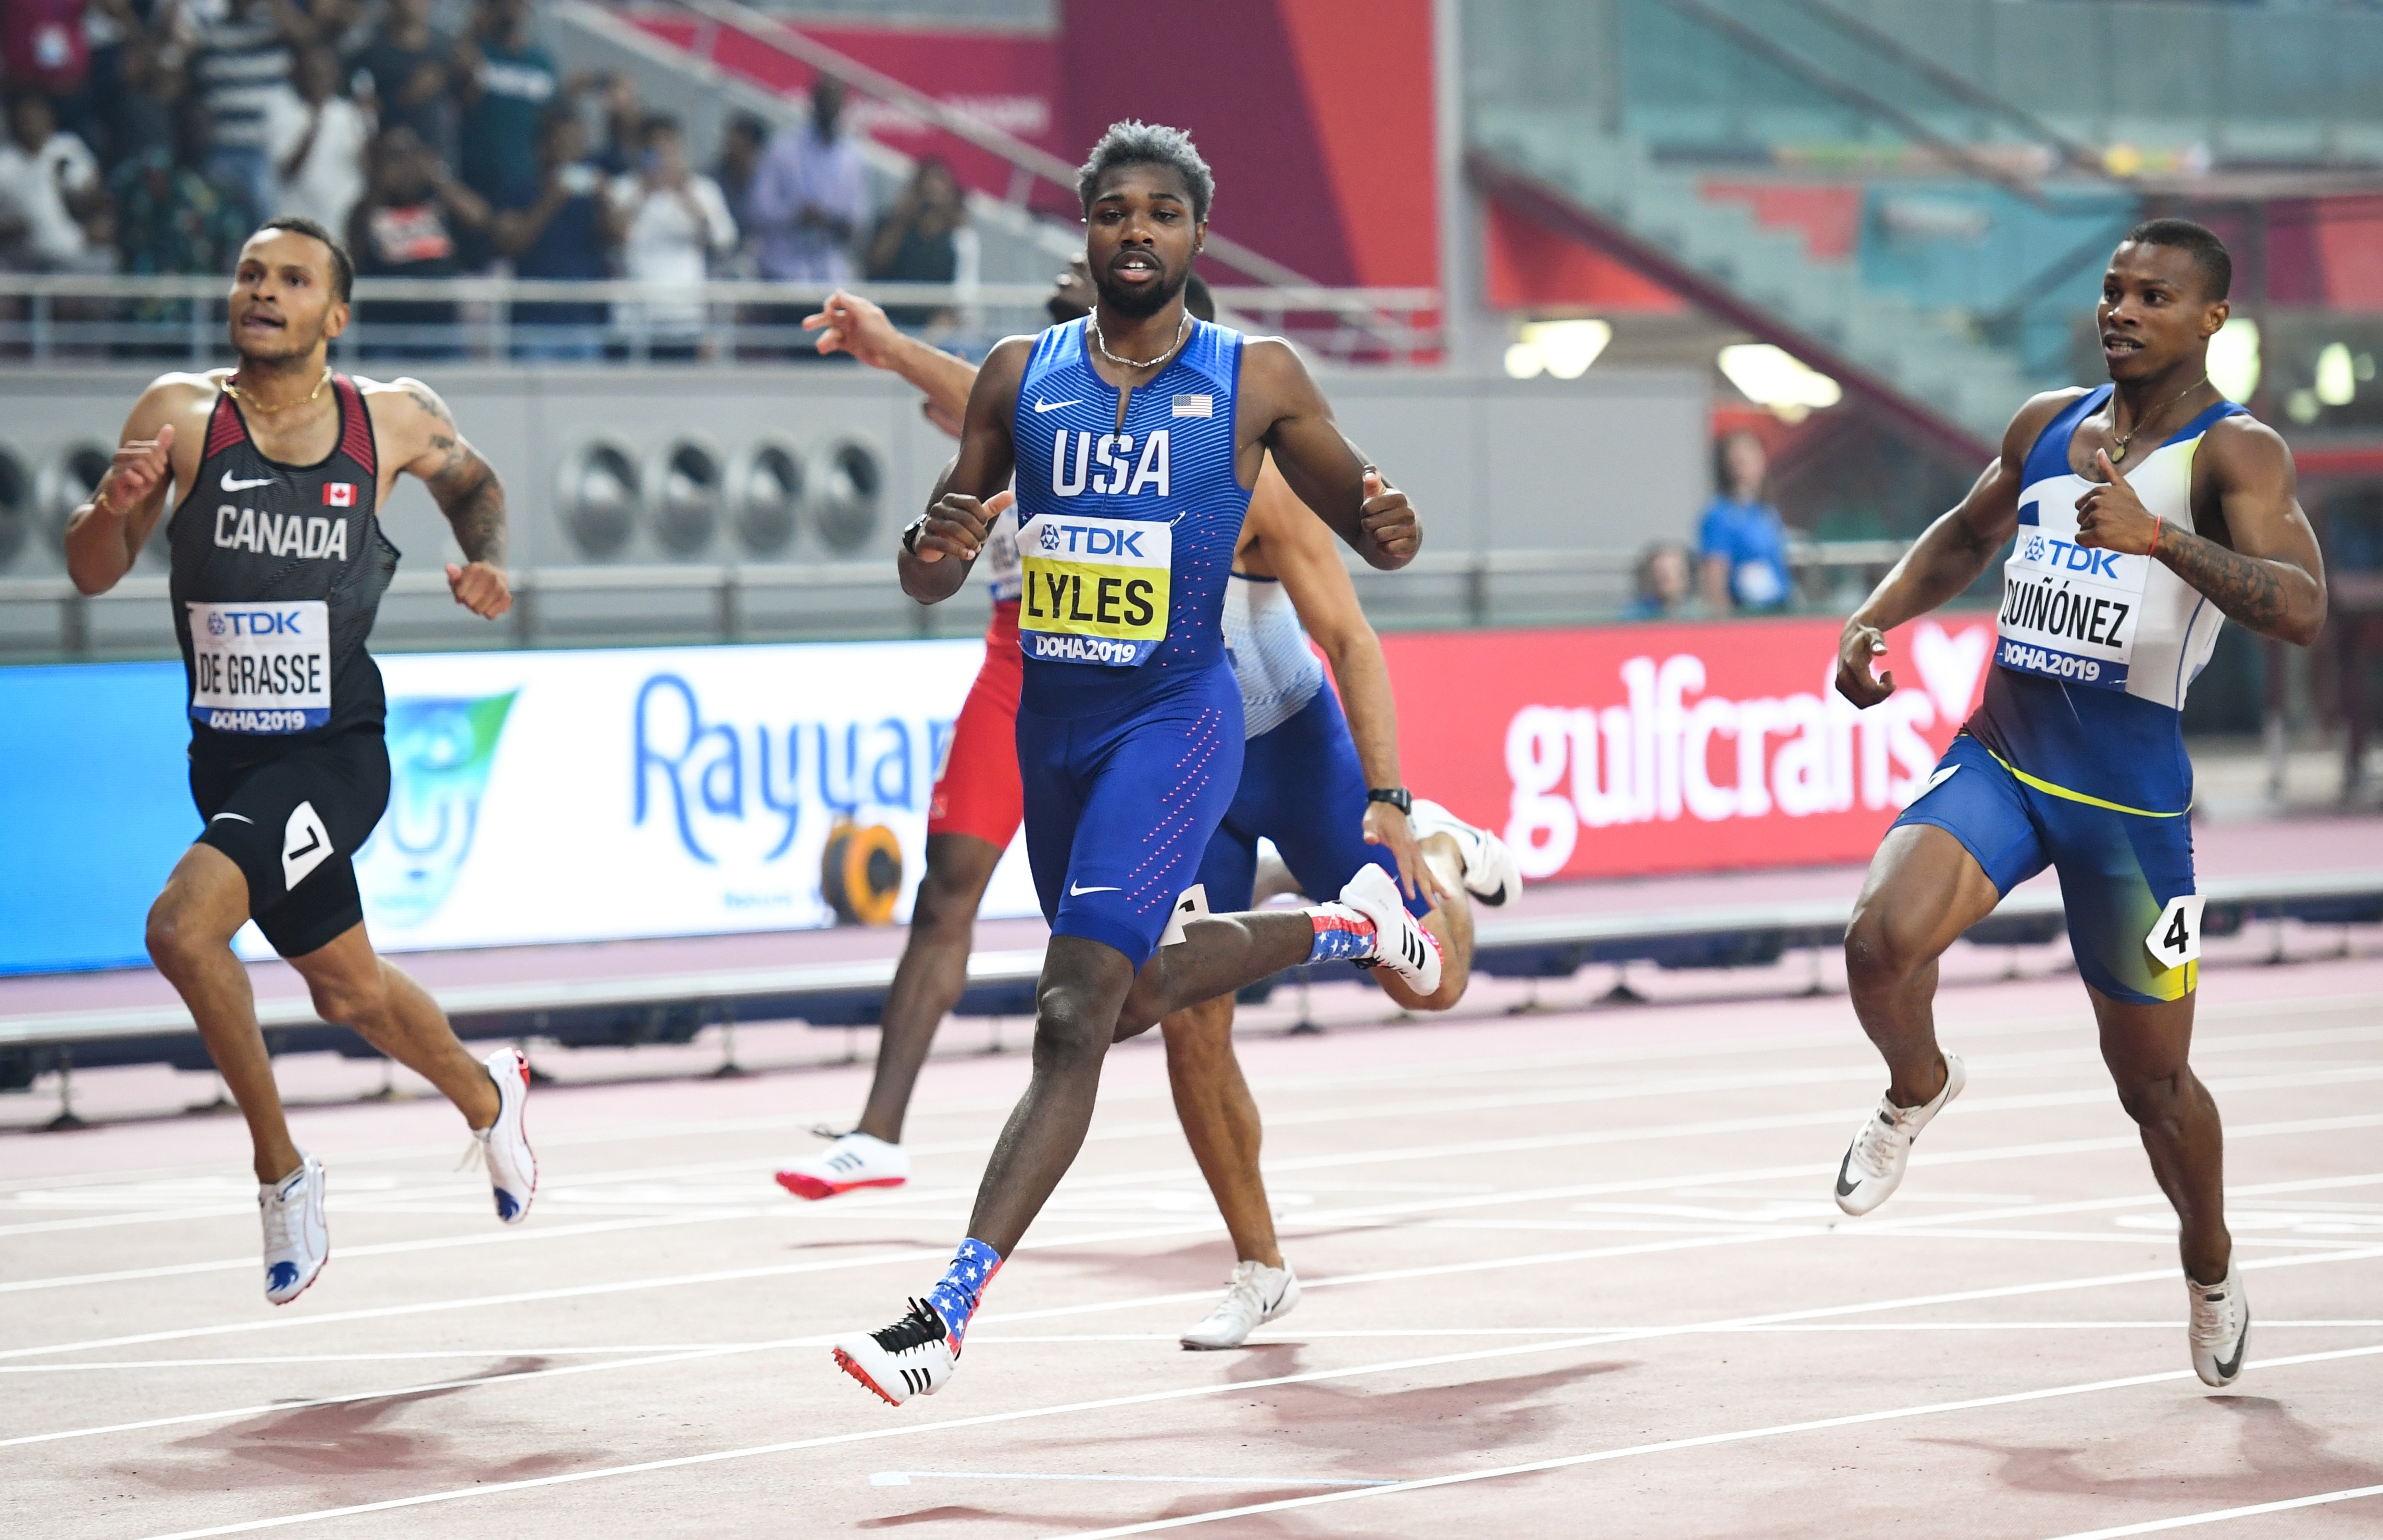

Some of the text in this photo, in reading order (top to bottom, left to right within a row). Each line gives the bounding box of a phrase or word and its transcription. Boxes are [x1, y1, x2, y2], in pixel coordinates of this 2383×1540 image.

[1052, 429, 1171, 497] USA
[214, 504, 348, 561] CANADA
[1061, 525, 1145, 558] TDK
[2049, 539, 2122, 580] TDK
[1028, 570, 1154, 626] LYLES
[2001, 576, 2130, 648] QUIÑÓNEZ
[224, 611, 302, 636] TDK
[1035, 635, 1136, 663] DOHA2019
[2004, 641, 2101, 682] DOHA2019
[199, 653, 321, 695] DE GRASSE
[210, 710, 306, 731] DOHA2019
[2163, 906, 2189, 955] 4
